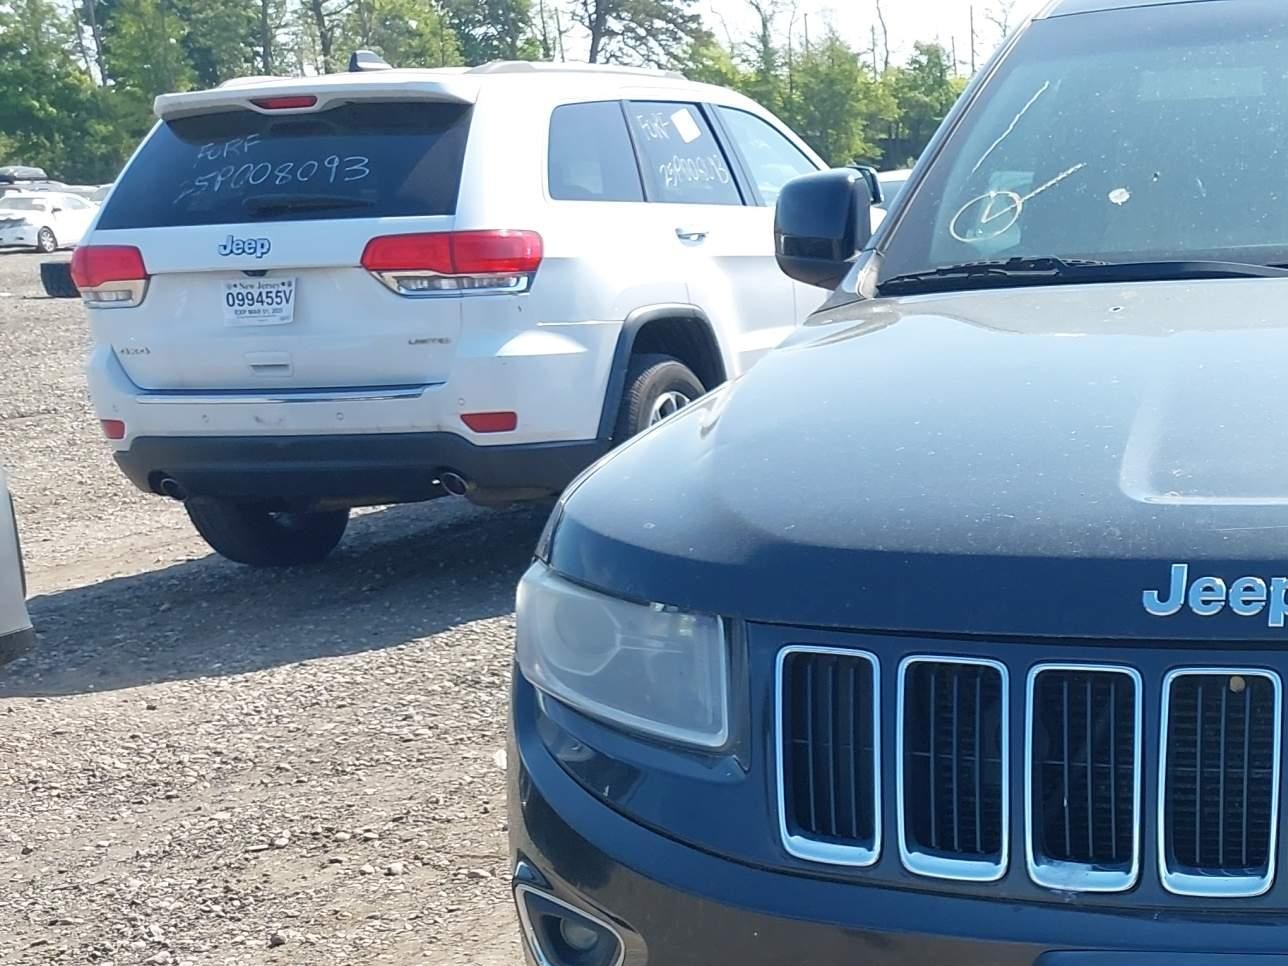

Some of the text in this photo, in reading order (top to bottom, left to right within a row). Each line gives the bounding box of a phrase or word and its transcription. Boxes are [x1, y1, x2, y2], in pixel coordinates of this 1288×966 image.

[218, 235, 271, 259] Jeep
[239, 281, 280, 290] New Jersey
[226, 289, 293, 308] 099455V
